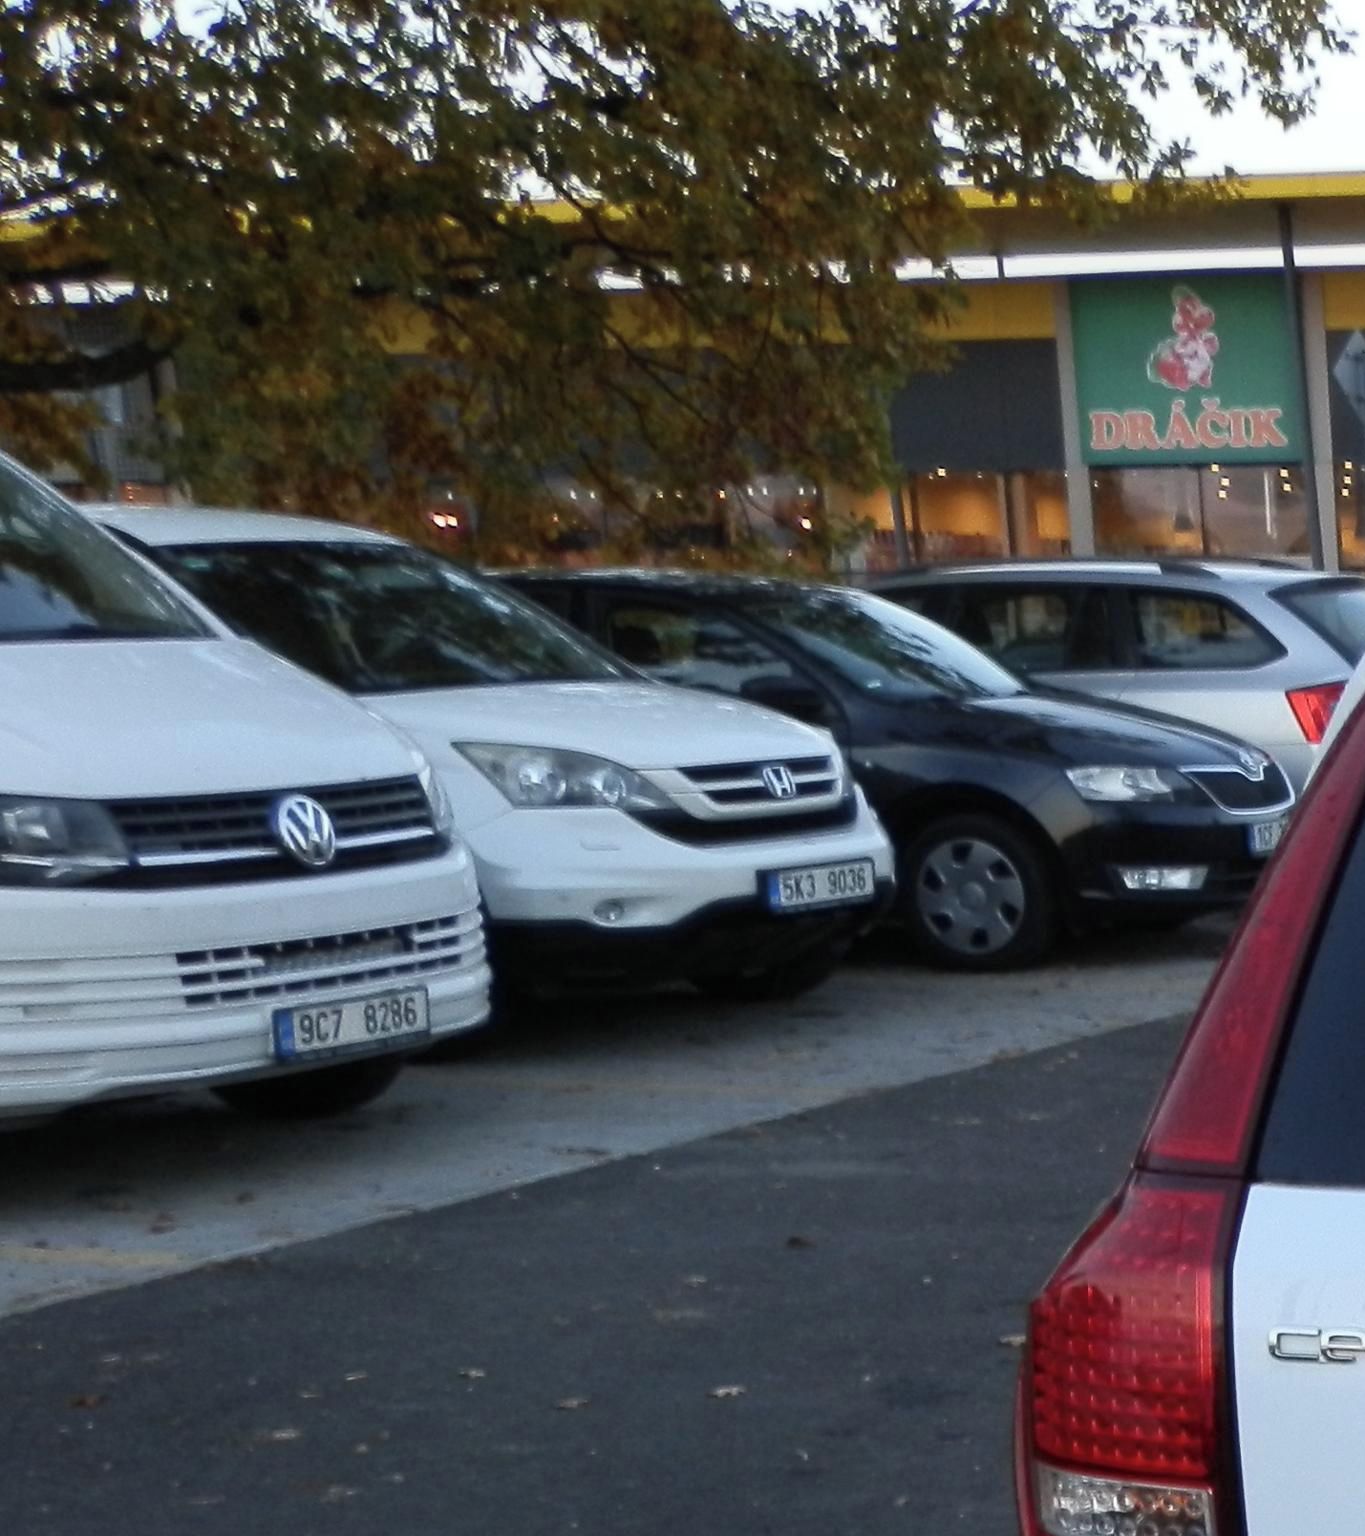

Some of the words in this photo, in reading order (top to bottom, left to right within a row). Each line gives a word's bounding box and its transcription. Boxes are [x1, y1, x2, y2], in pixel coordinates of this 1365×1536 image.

[1089, 397, 1289, 451] DRÁČIK
[300, 1009, 343, 1044] 9C7
[363, 997, 417, 1035] 8286
